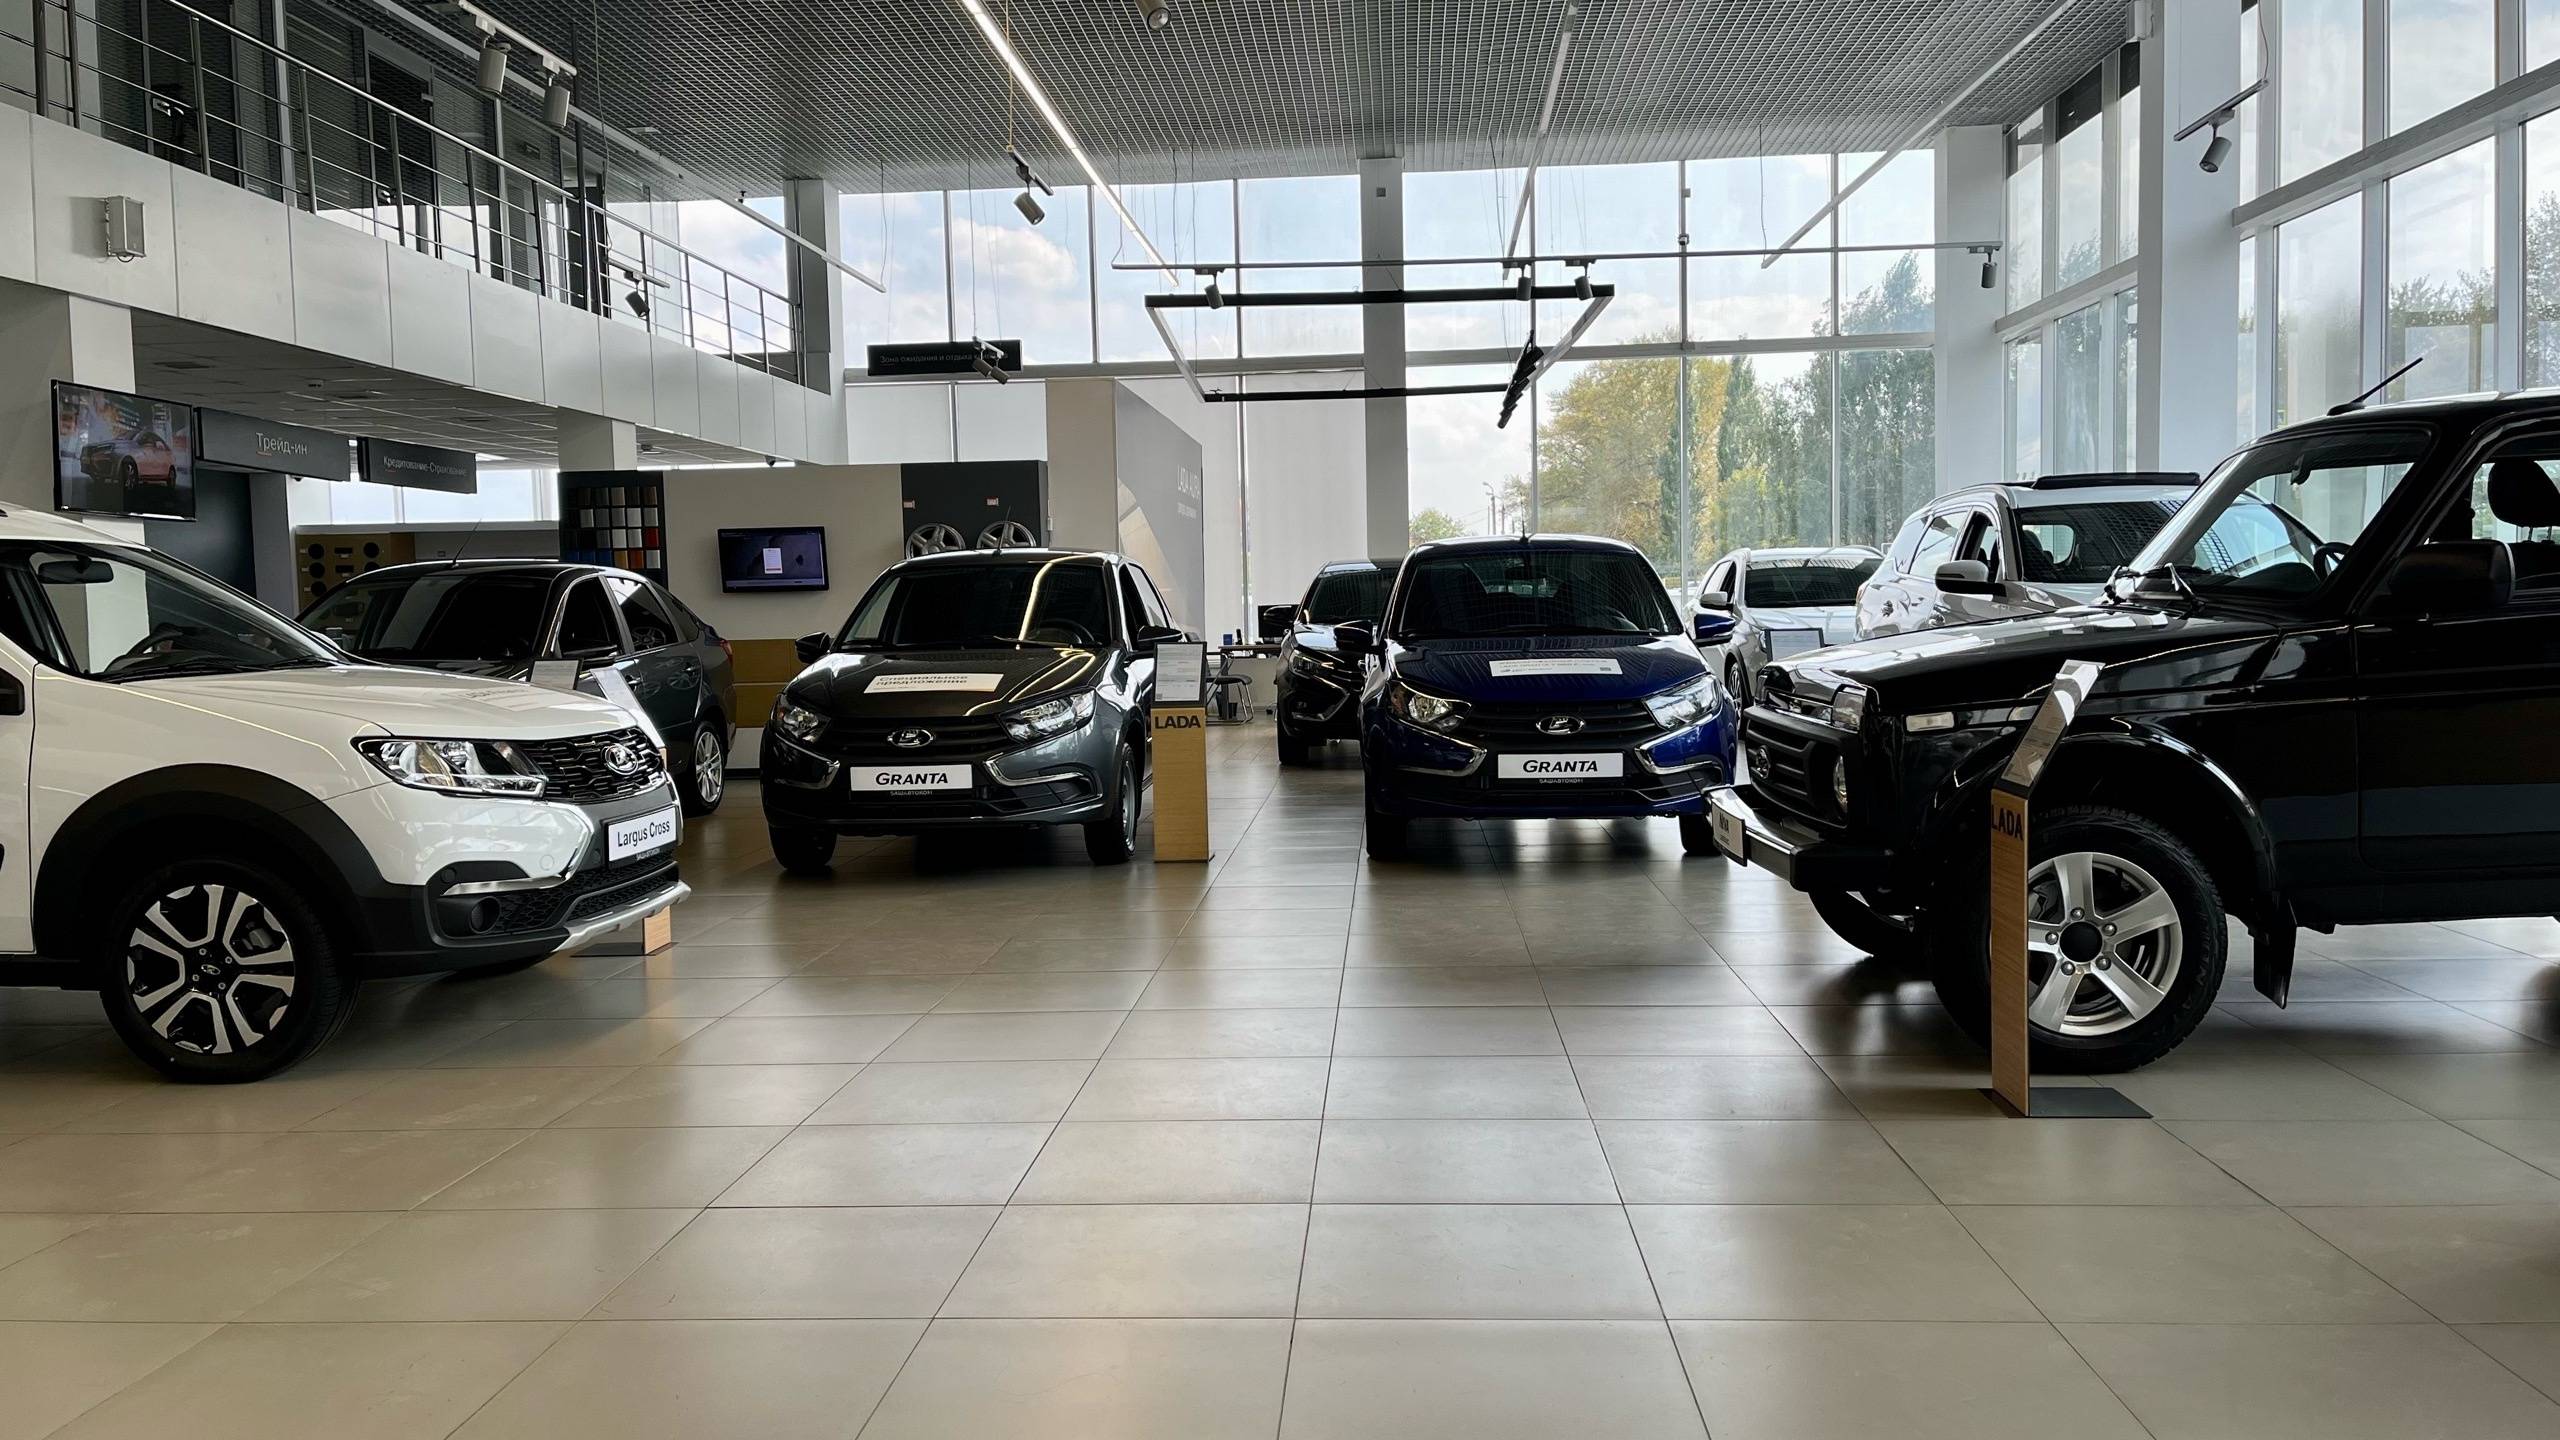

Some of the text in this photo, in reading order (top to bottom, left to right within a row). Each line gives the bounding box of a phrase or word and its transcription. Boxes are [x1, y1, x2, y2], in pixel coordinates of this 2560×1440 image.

[256, 432, 308, 455] Трейд-ин
[1154, 715, 1201, 729] LADA
[1523, 760, 1598, 773] GRANTA
[875, 772, 948, 785] GRANTA
[1991, 804, 2023, 841] LADA
[617, 821, 670, 847] Largus Cross
